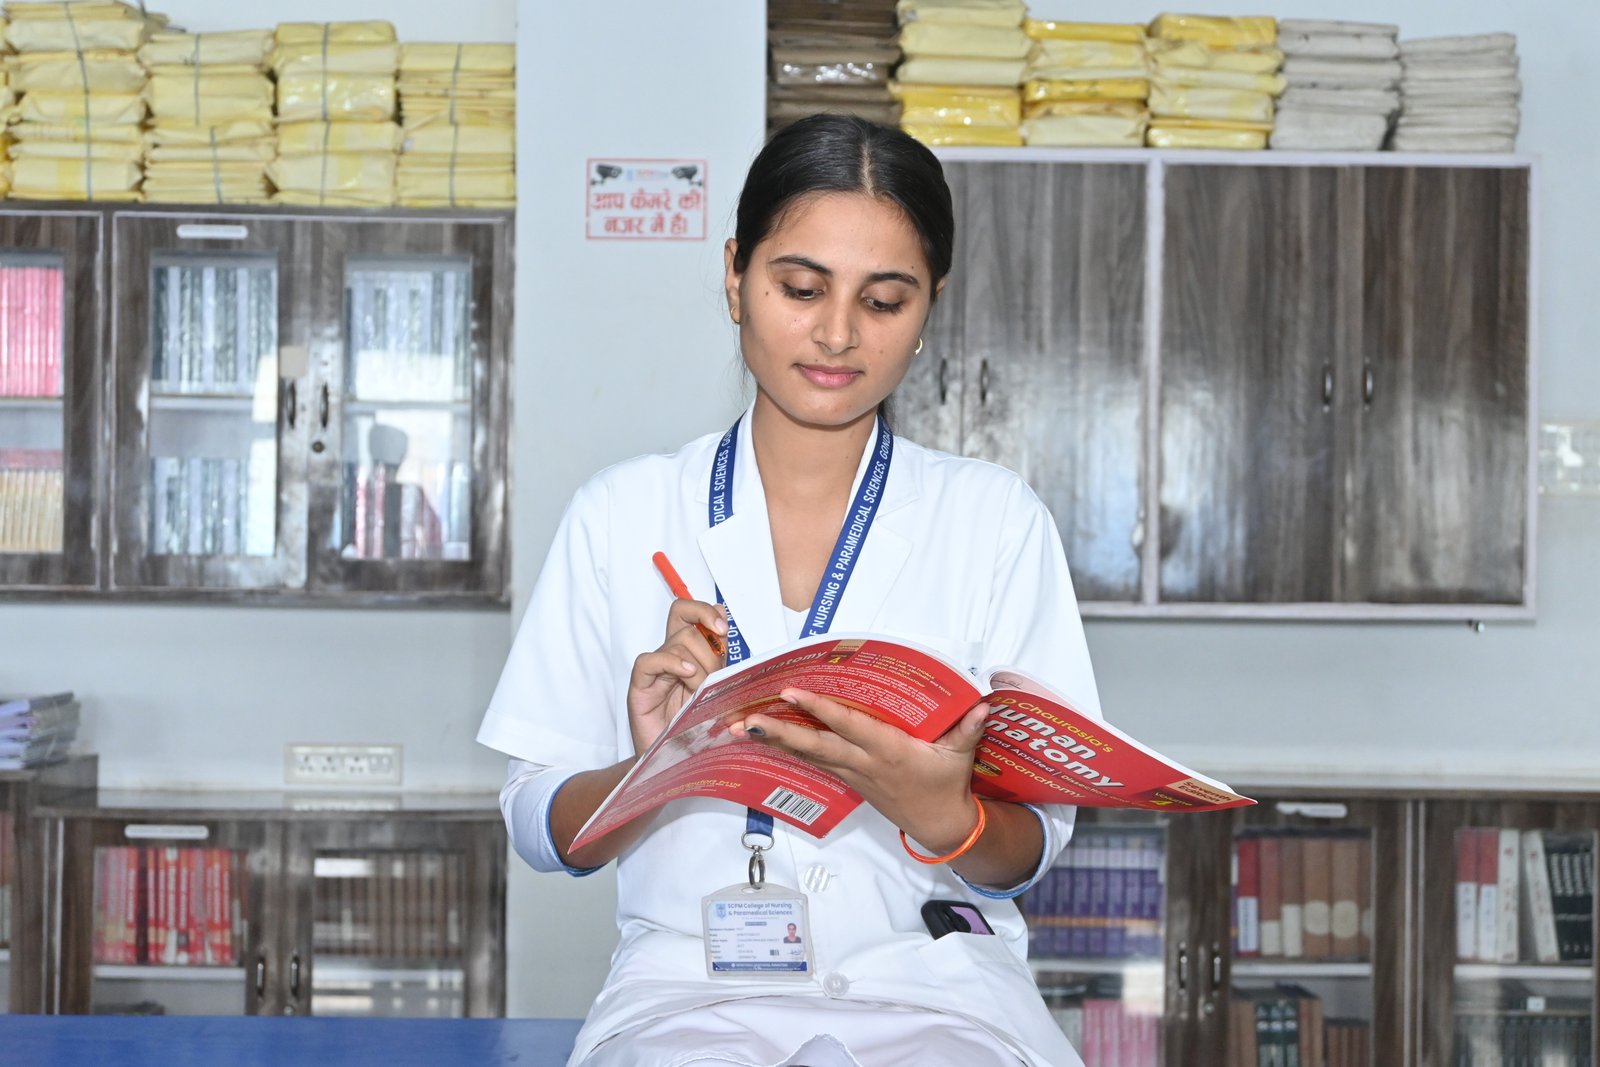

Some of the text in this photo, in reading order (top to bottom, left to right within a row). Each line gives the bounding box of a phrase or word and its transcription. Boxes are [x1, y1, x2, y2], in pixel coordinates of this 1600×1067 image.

[592, 193, 624, 209] आप
[835, 505, 872, 571] PARAMEDICAL
[831, 572, 845, 581] &
[813, 581, 840, 628] NURSING
[727, 625, 739, 638] OF
[729, 640, 742, 661] EGE
[757, 650, 828, 674] Anatomy
[1018, 702, 1114, 753] Chaurasia's
[985, 719, 1125, 788] natomy
[987, 736, 1012, 749] and
[1010, 748, 1057, 773] Applied
[1183, 781, 1232, 801] Seventh
[770, 902, 792, 910] Nursing
